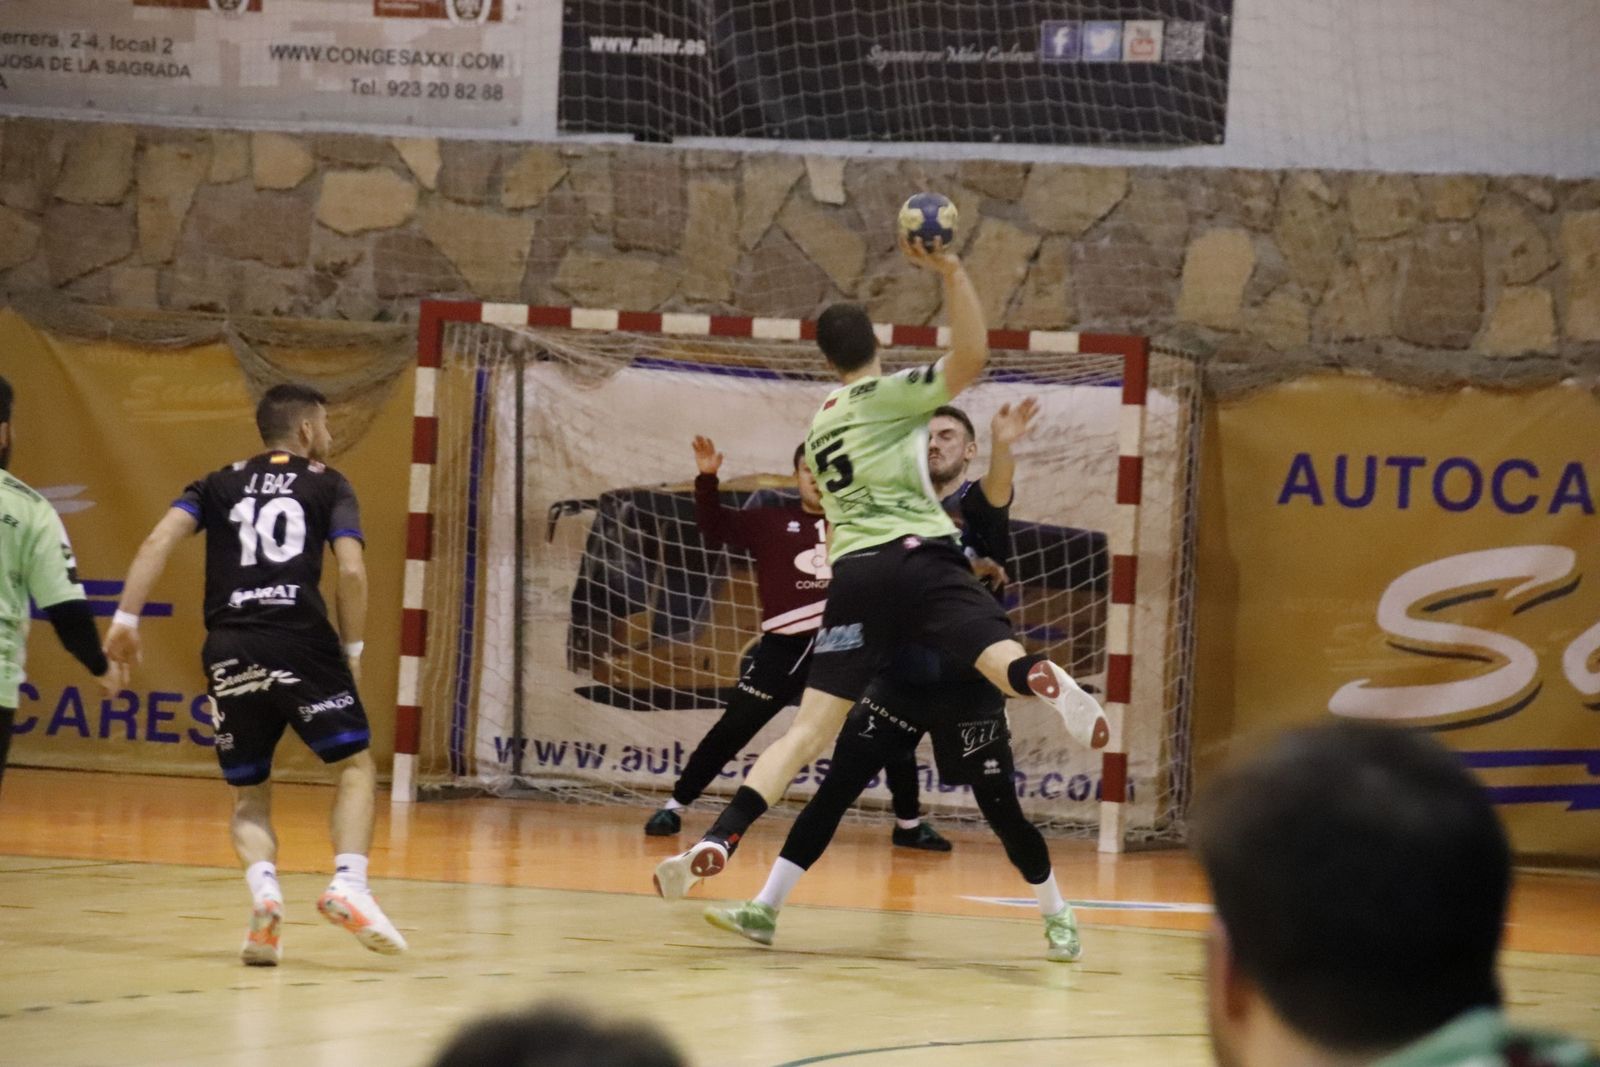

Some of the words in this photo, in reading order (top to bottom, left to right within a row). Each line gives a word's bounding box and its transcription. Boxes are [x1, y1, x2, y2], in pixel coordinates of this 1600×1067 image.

[110, 35, 156, 53] local
[163, 38, 173, 54] 2
[50, 56, 73, 72] DE
[79, 58, 99, 73] LA
[105, 59, 191, 78] SAGRADA
[387, 80, 422, 98] 923
[427, 81, 449, 98] 20
[455, 83, 476, 100] 82
[815, 439, 853, 493] 5
[261, 472, 298, 494] BAZ
[1277, 452, 1595, 515] AUTOCA
[229, 496, 307, 567] 10
